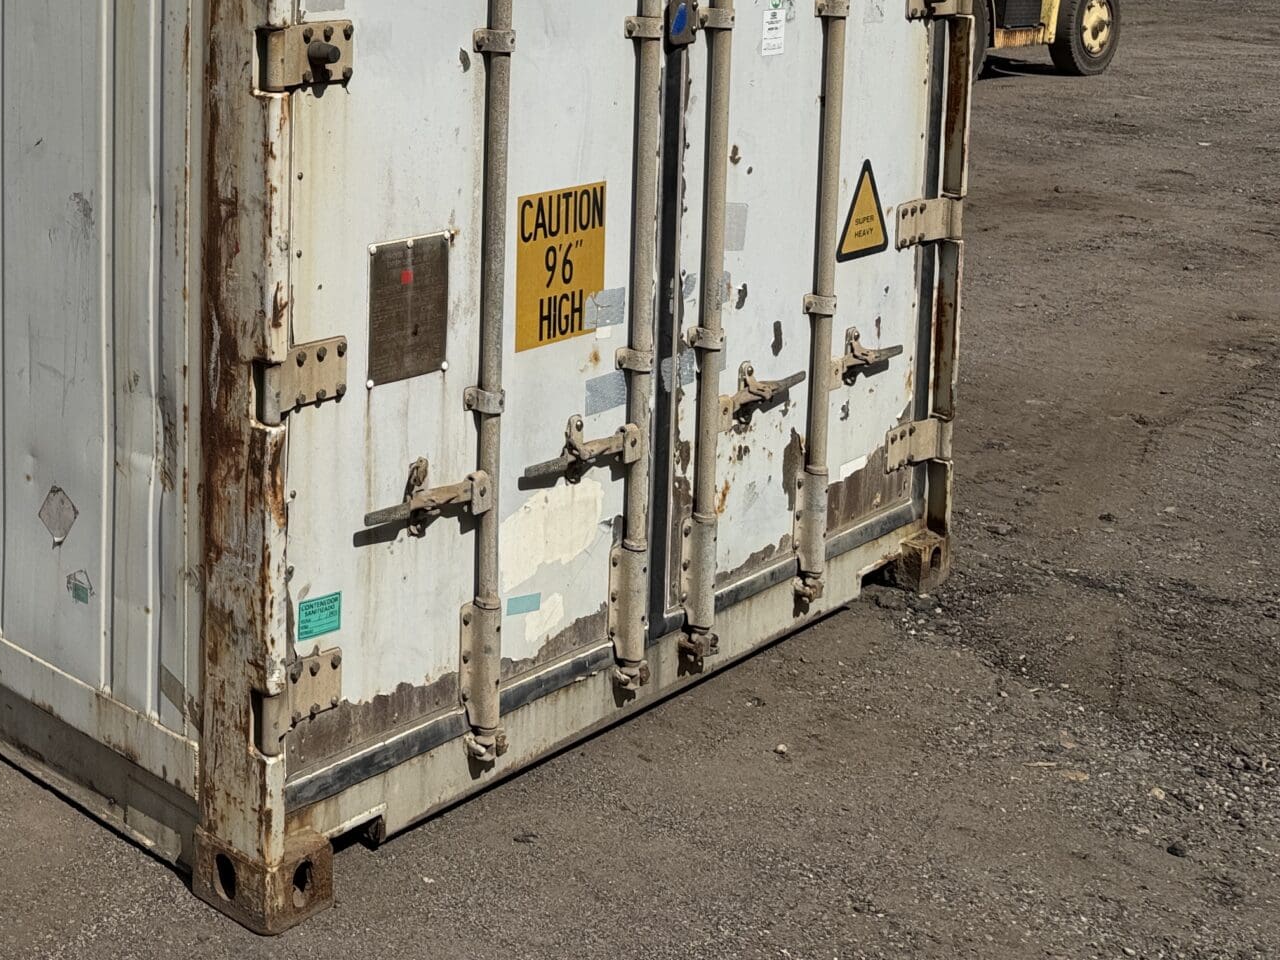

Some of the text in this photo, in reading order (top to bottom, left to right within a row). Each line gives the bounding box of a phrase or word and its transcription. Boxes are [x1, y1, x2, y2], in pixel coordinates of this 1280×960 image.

[520, 185, 604, 243] CAUTION
[855, 214, 875, 226] SUPER
[854, 227, 874, 239] HEAVY
[538, 289, 583, 342] HIGH
